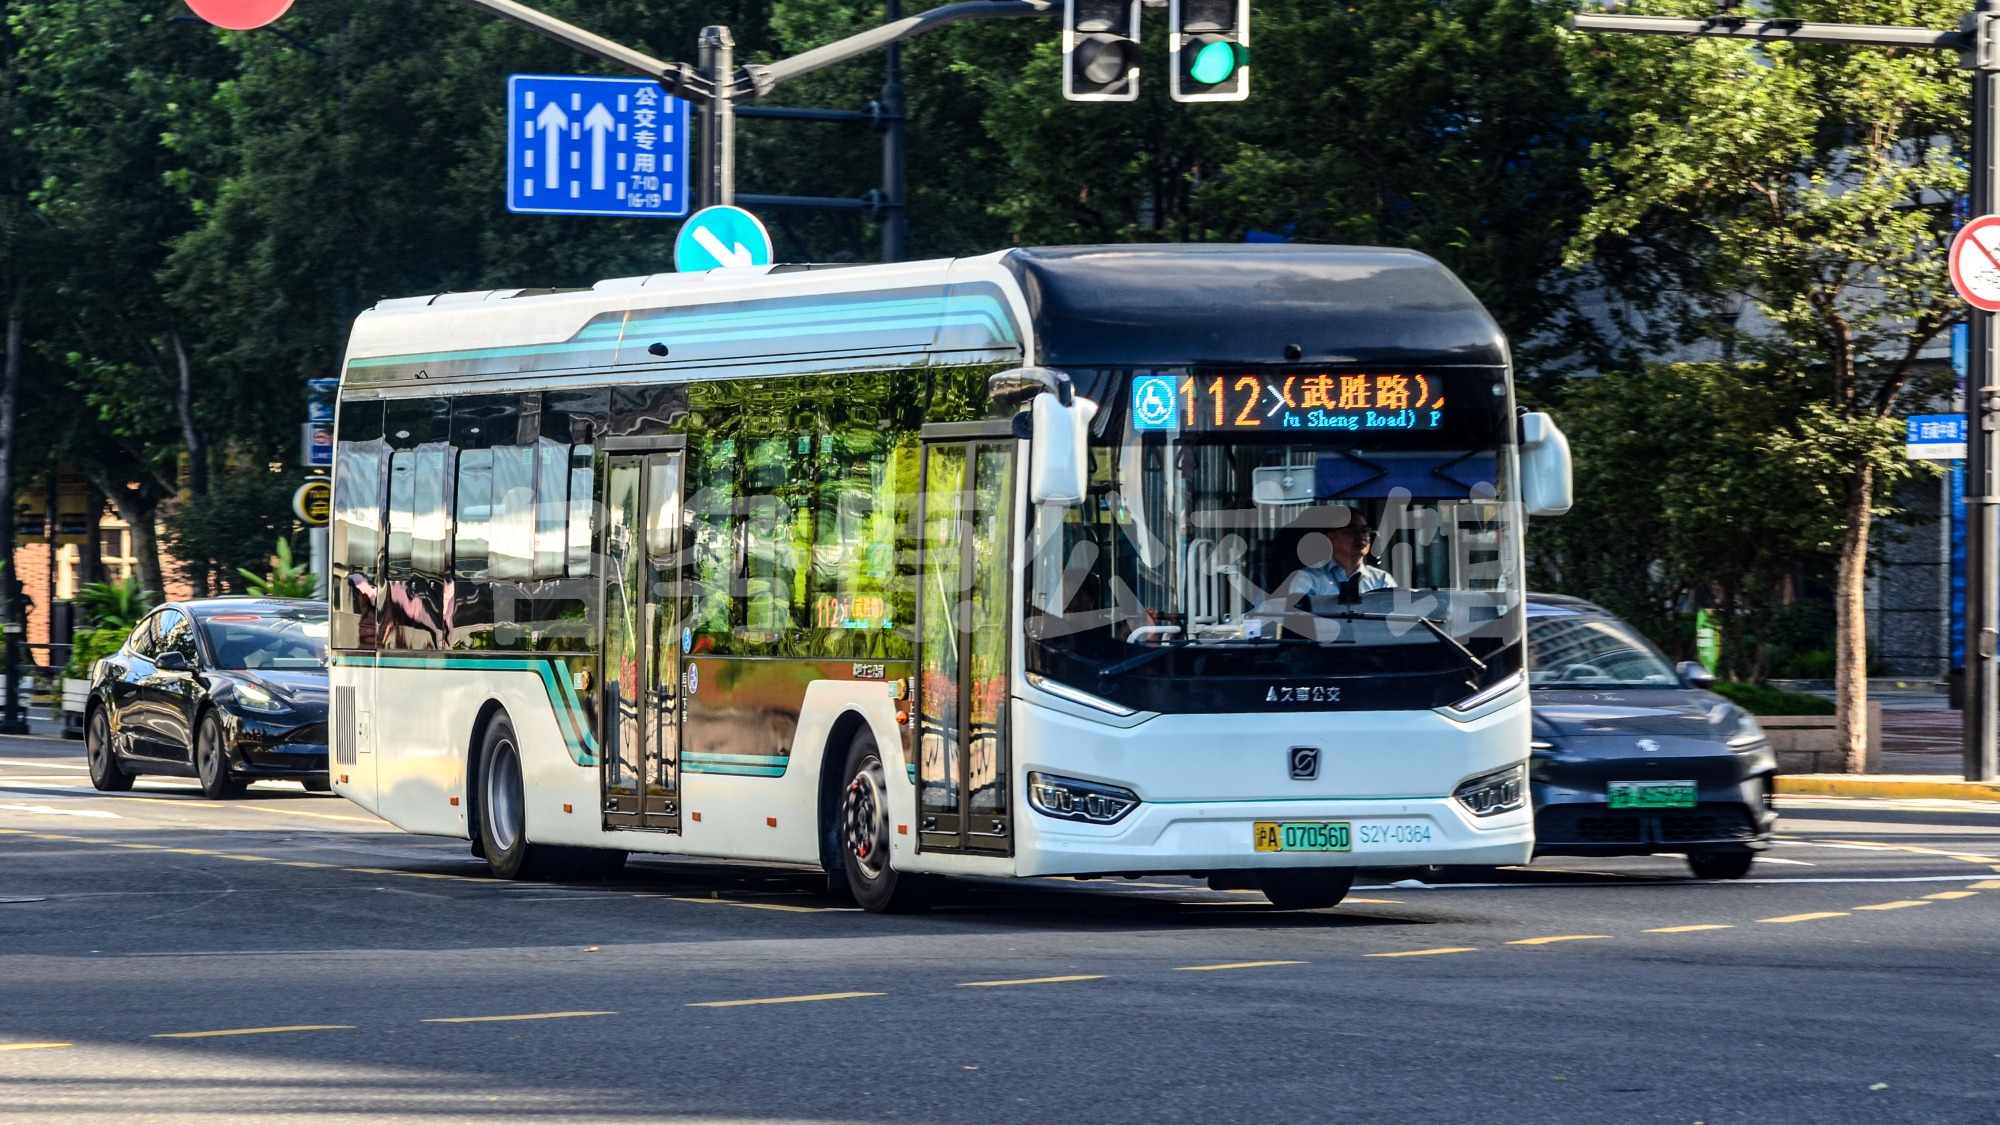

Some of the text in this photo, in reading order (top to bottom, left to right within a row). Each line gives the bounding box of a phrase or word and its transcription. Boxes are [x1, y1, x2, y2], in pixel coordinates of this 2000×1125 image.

[633, 86, 658, 173] 公交专用
[1179, 376, 1261, 427] 112
[1308, 410, 1359, 431] Sheng
[817, 596, 838, 628] 112
[1280, 686, 1341, 702] 久事公交
[1359, 824, 1432, 844] S2Y-0364
